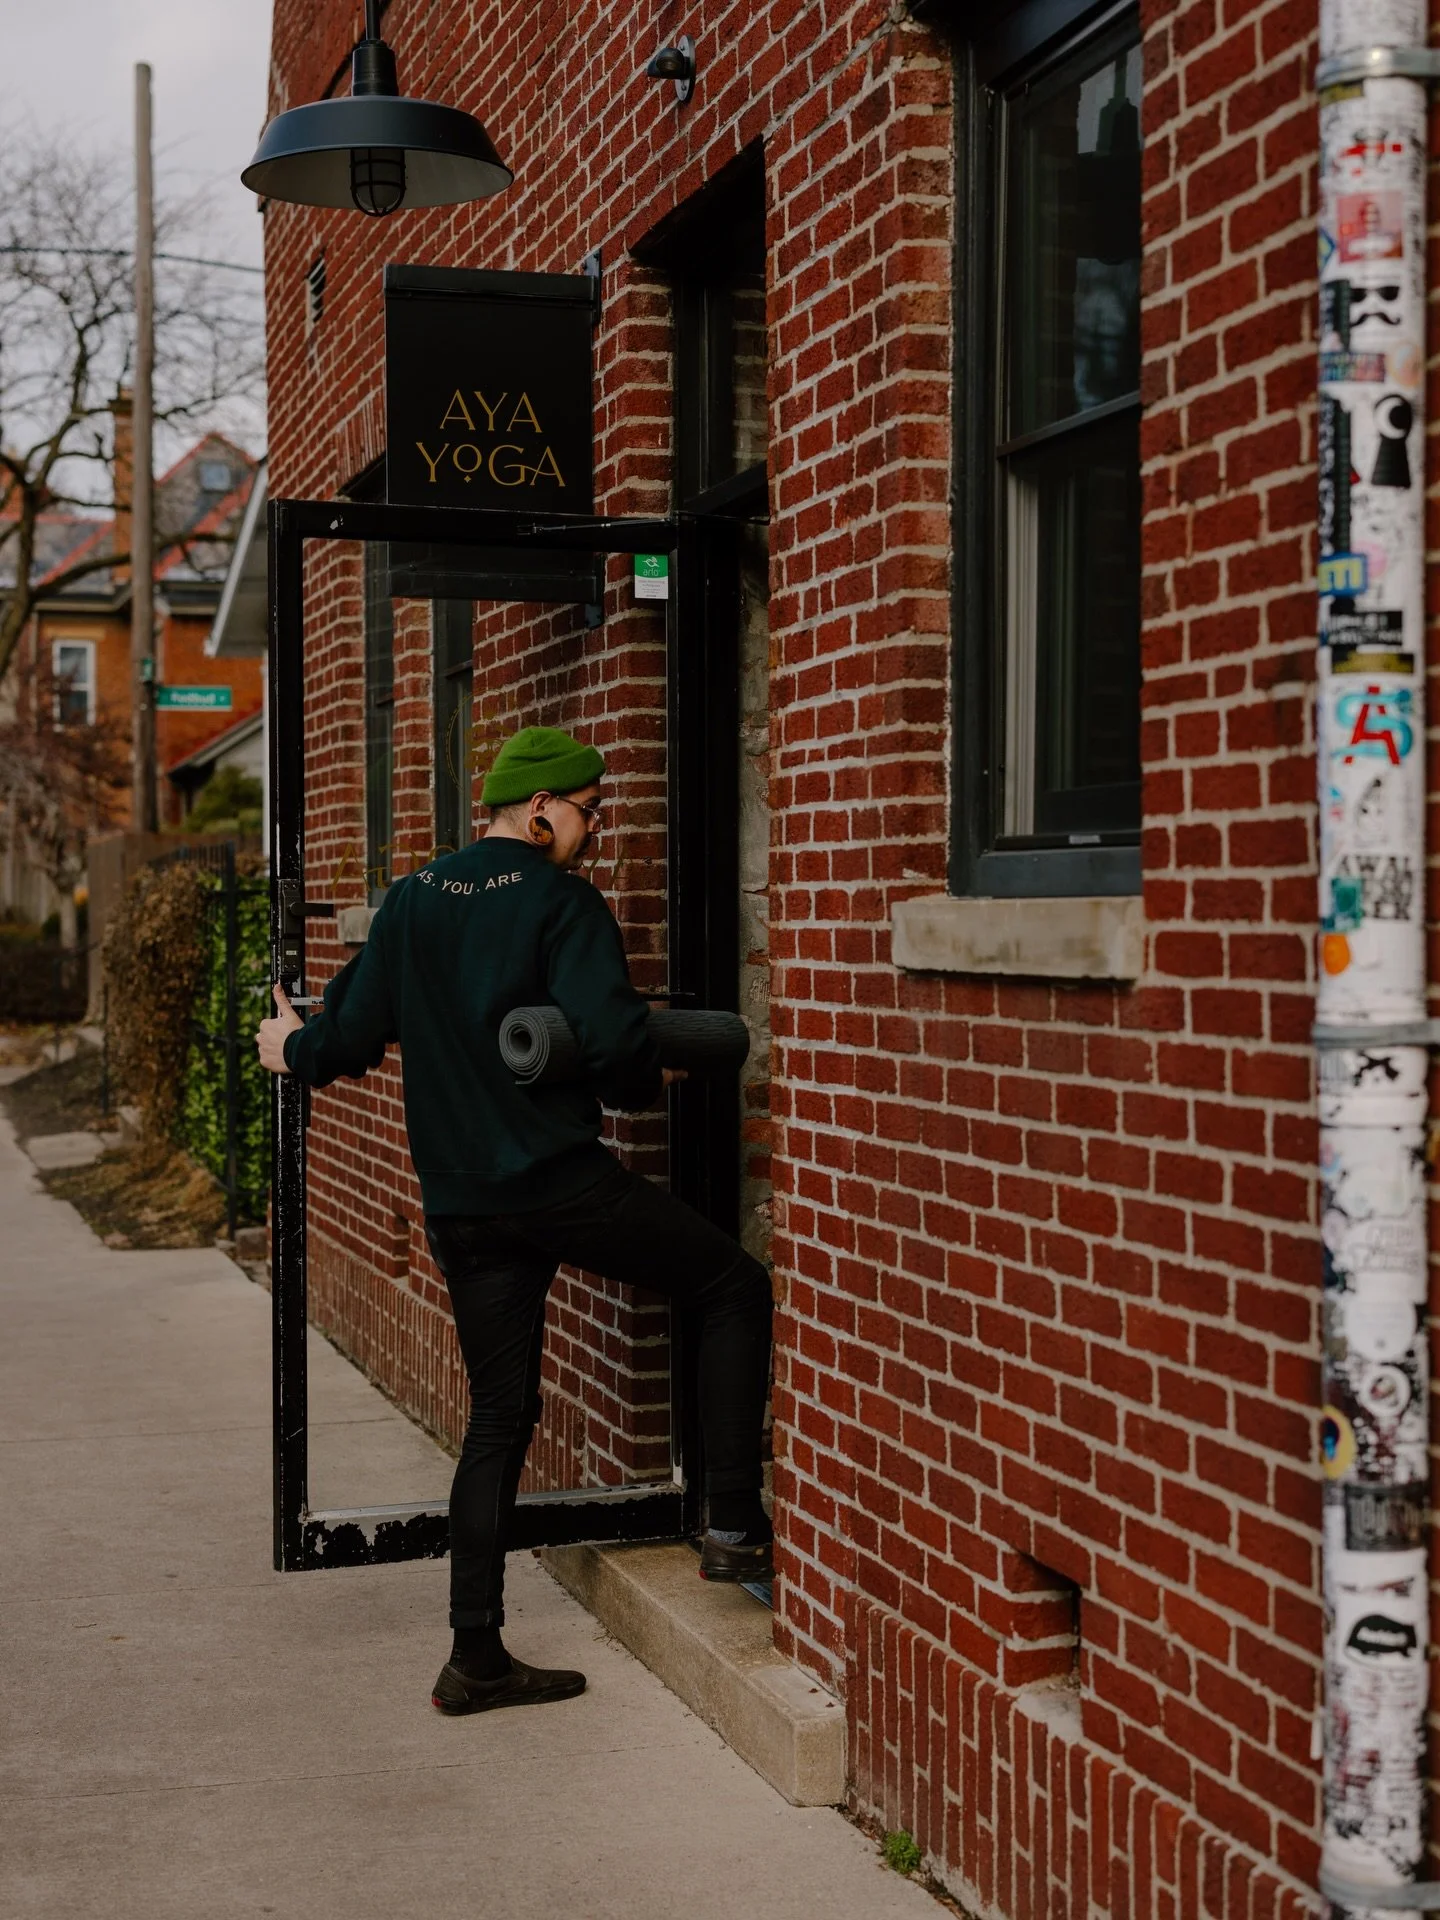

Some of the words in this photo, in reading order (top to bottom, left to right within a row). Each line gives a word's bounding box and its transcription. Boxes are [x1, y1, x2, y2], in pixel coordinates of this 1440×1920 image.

[440, 389, 542, 433] AYA
[416, 442, 566, 487] YOGA
[485, 871, 523, 890] ARE
